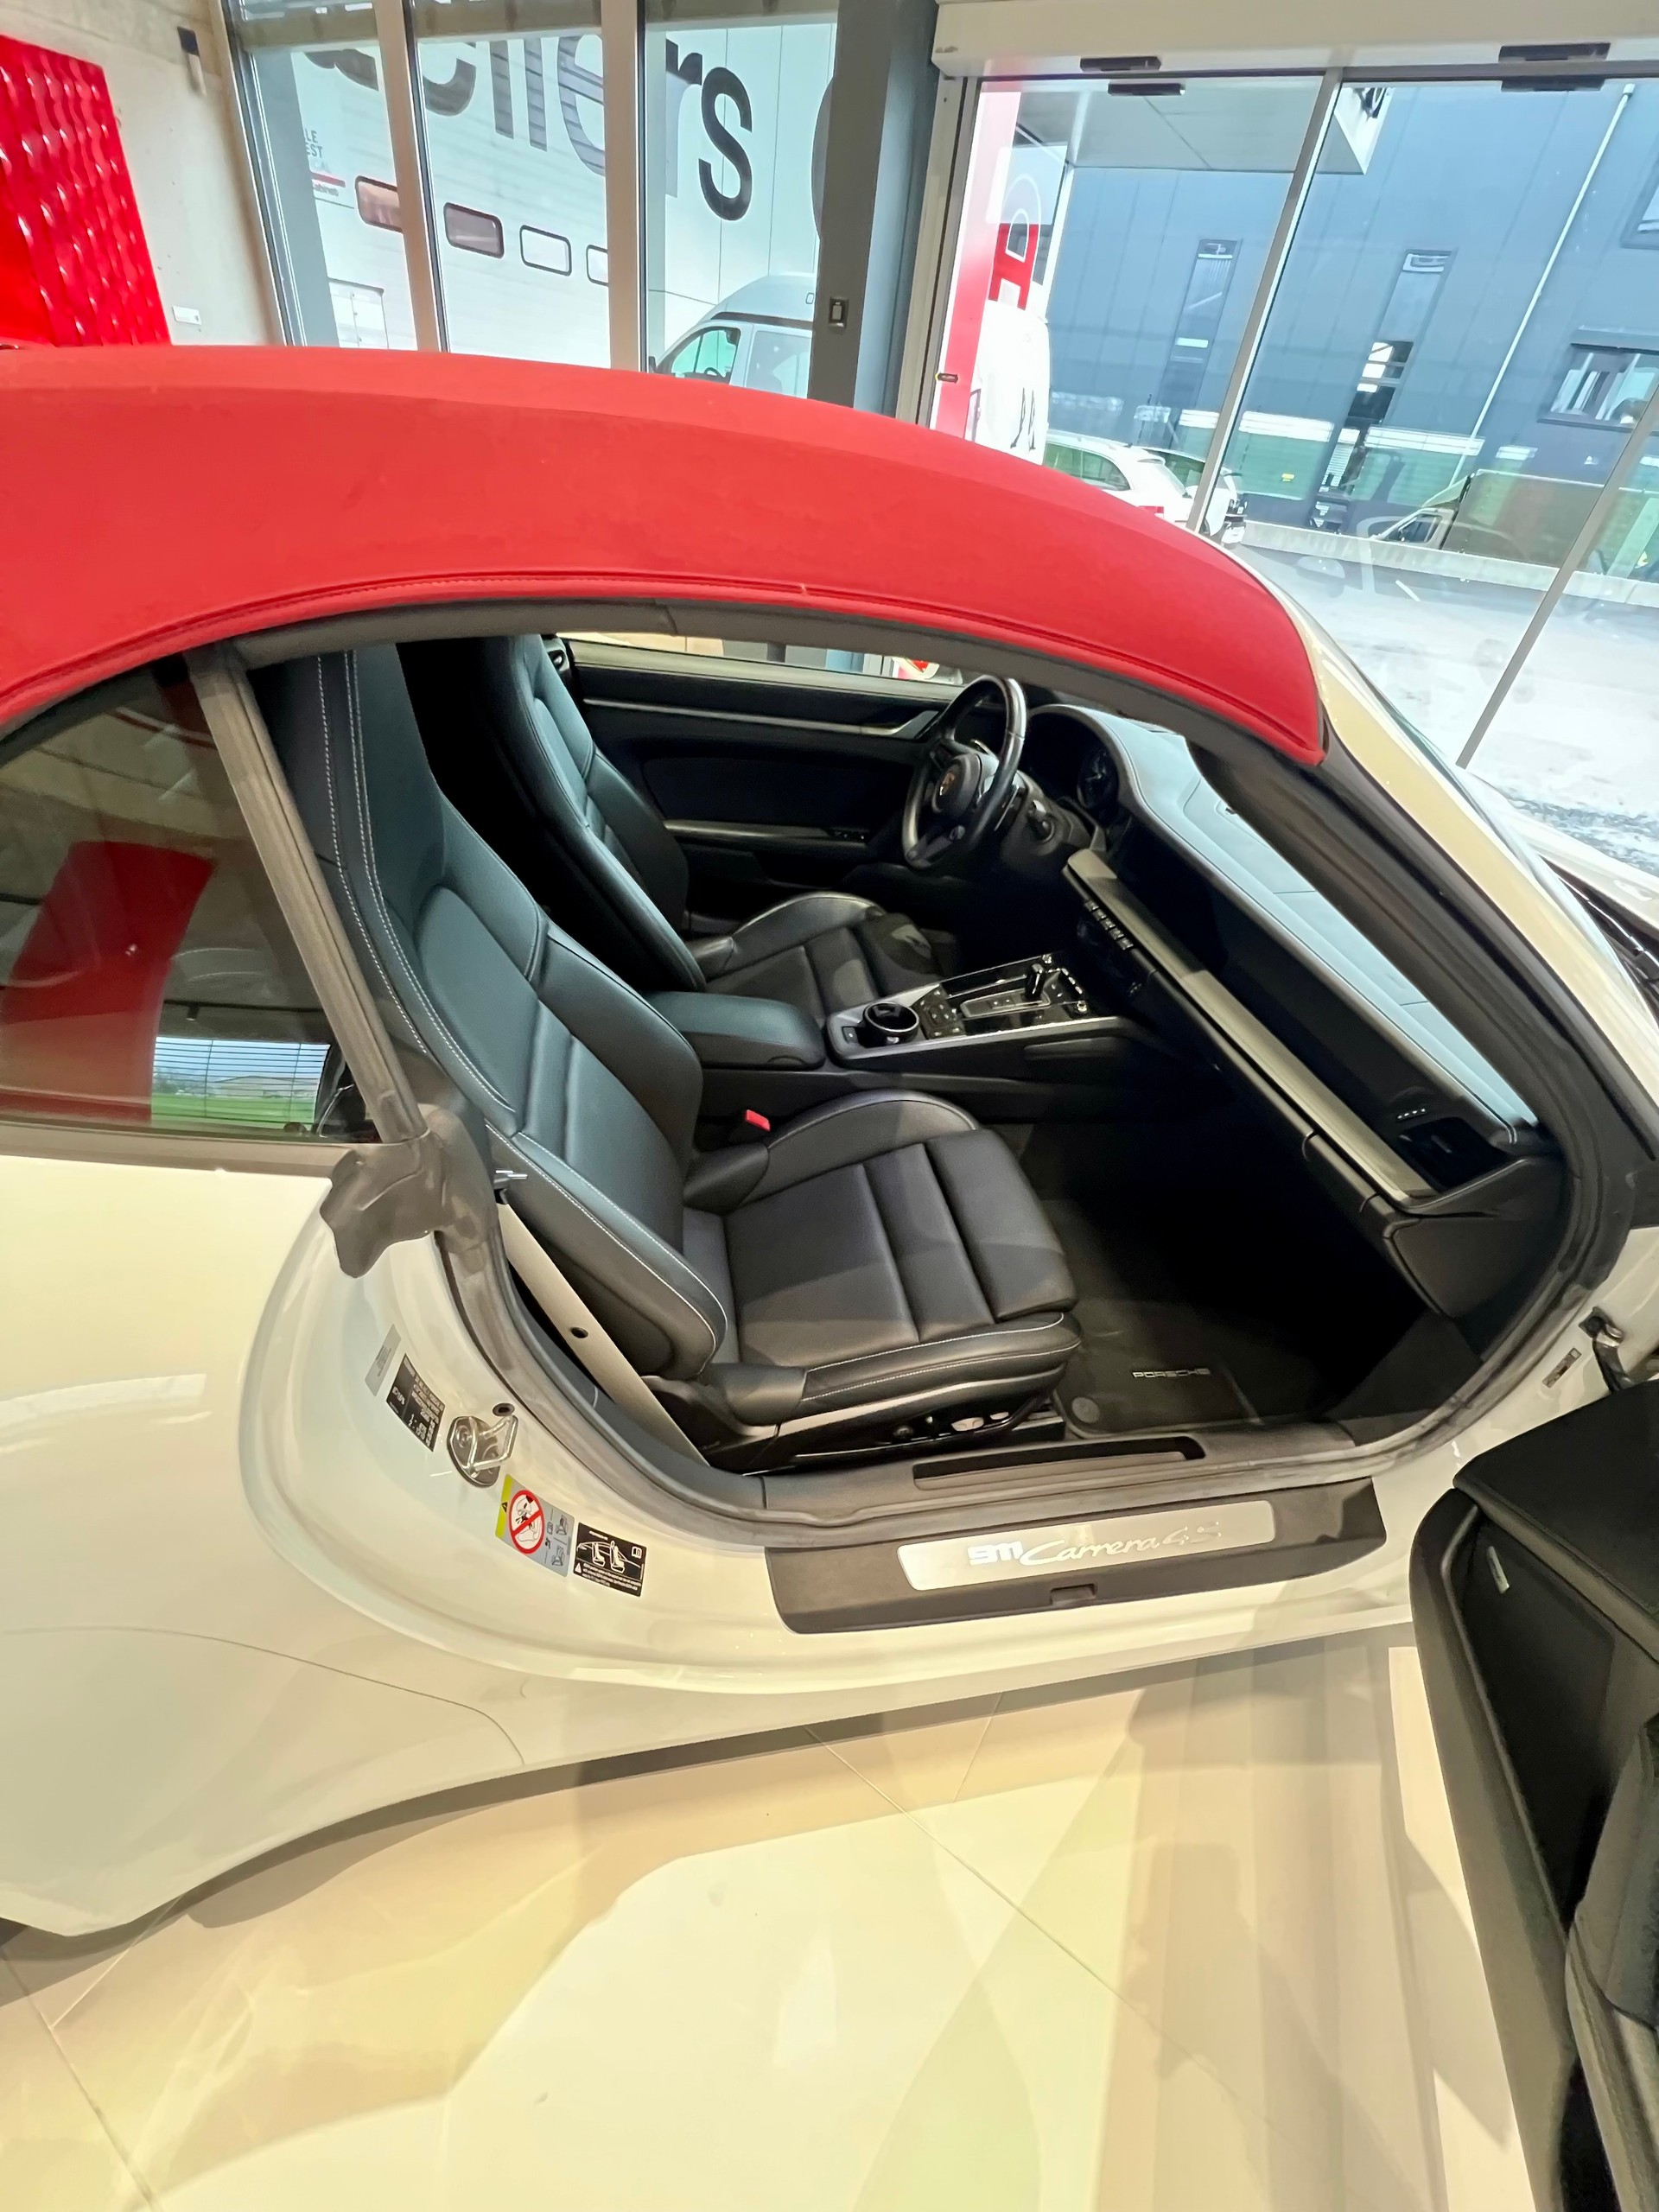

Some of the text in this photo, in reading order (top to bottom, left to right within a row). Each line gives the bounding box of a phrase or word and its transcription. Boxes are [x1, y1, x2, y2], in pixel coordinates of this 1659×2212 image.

[1132, 1368, 1210, 1378] PORSCHE
[967, 1541, 1023, 1566] 911
[1020, 1536, 1160, 1566] Carrera
